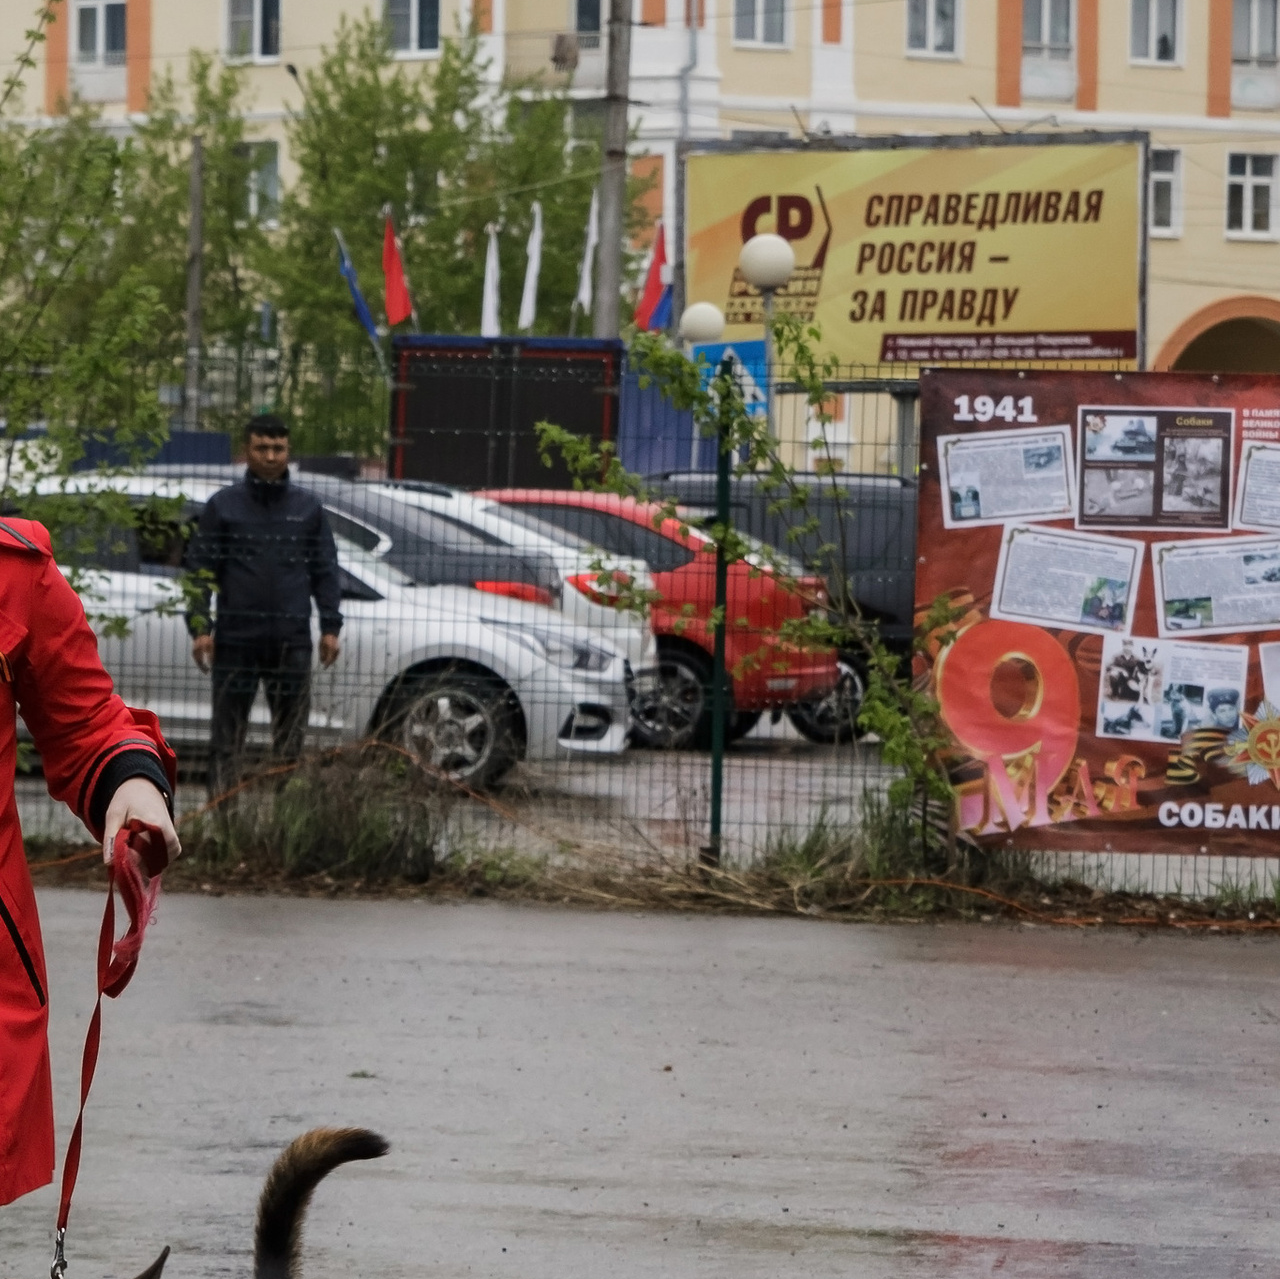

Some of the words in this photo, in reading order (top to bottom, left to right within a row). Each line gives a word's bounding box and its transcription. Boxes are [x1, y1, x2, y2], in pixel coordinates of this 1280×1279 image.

[864, 190, 1104, 231] СПРАВЕДЛИВАЯ
[856, 241, 977, 275] РОССИЯ
[848, 289, 886, 323] ЗА
[899, 287, 1020, 327] ПРАВДУ
[952, 394, 1039, 423] 1941
